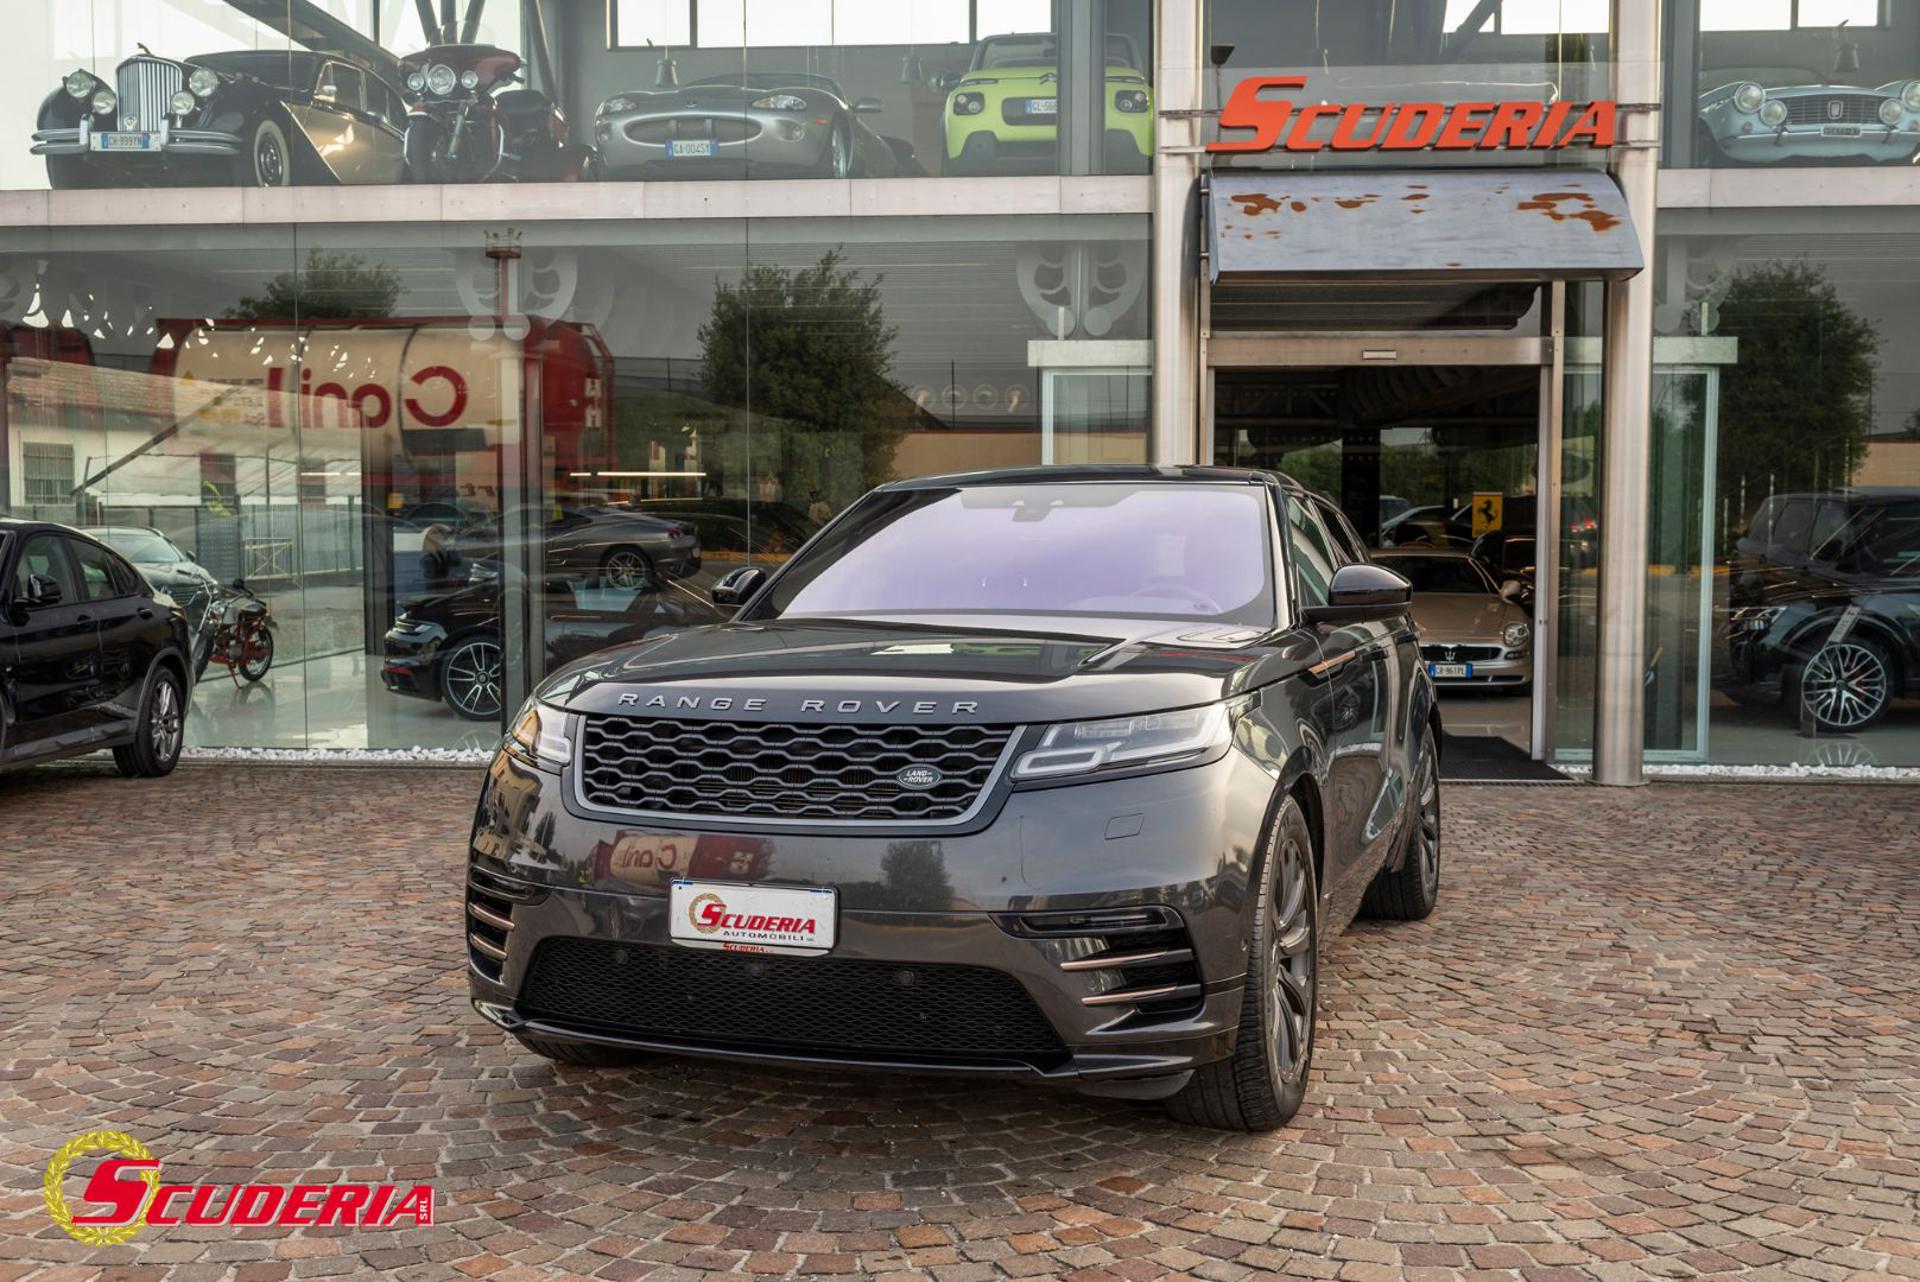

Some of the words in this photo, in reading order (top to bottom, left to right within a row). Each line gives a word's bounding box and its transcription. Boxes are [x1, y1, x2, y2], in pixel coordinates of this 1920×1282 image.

[1206, 75, 1616, 153] SCUDERIA
[617, 692, 768, 712] RANGE
[800, 699, 980, 715] ROVER
[697, 903, 817, 934] SCUDERIA
[722, 930, 804, 942] AUTOMOBILI
